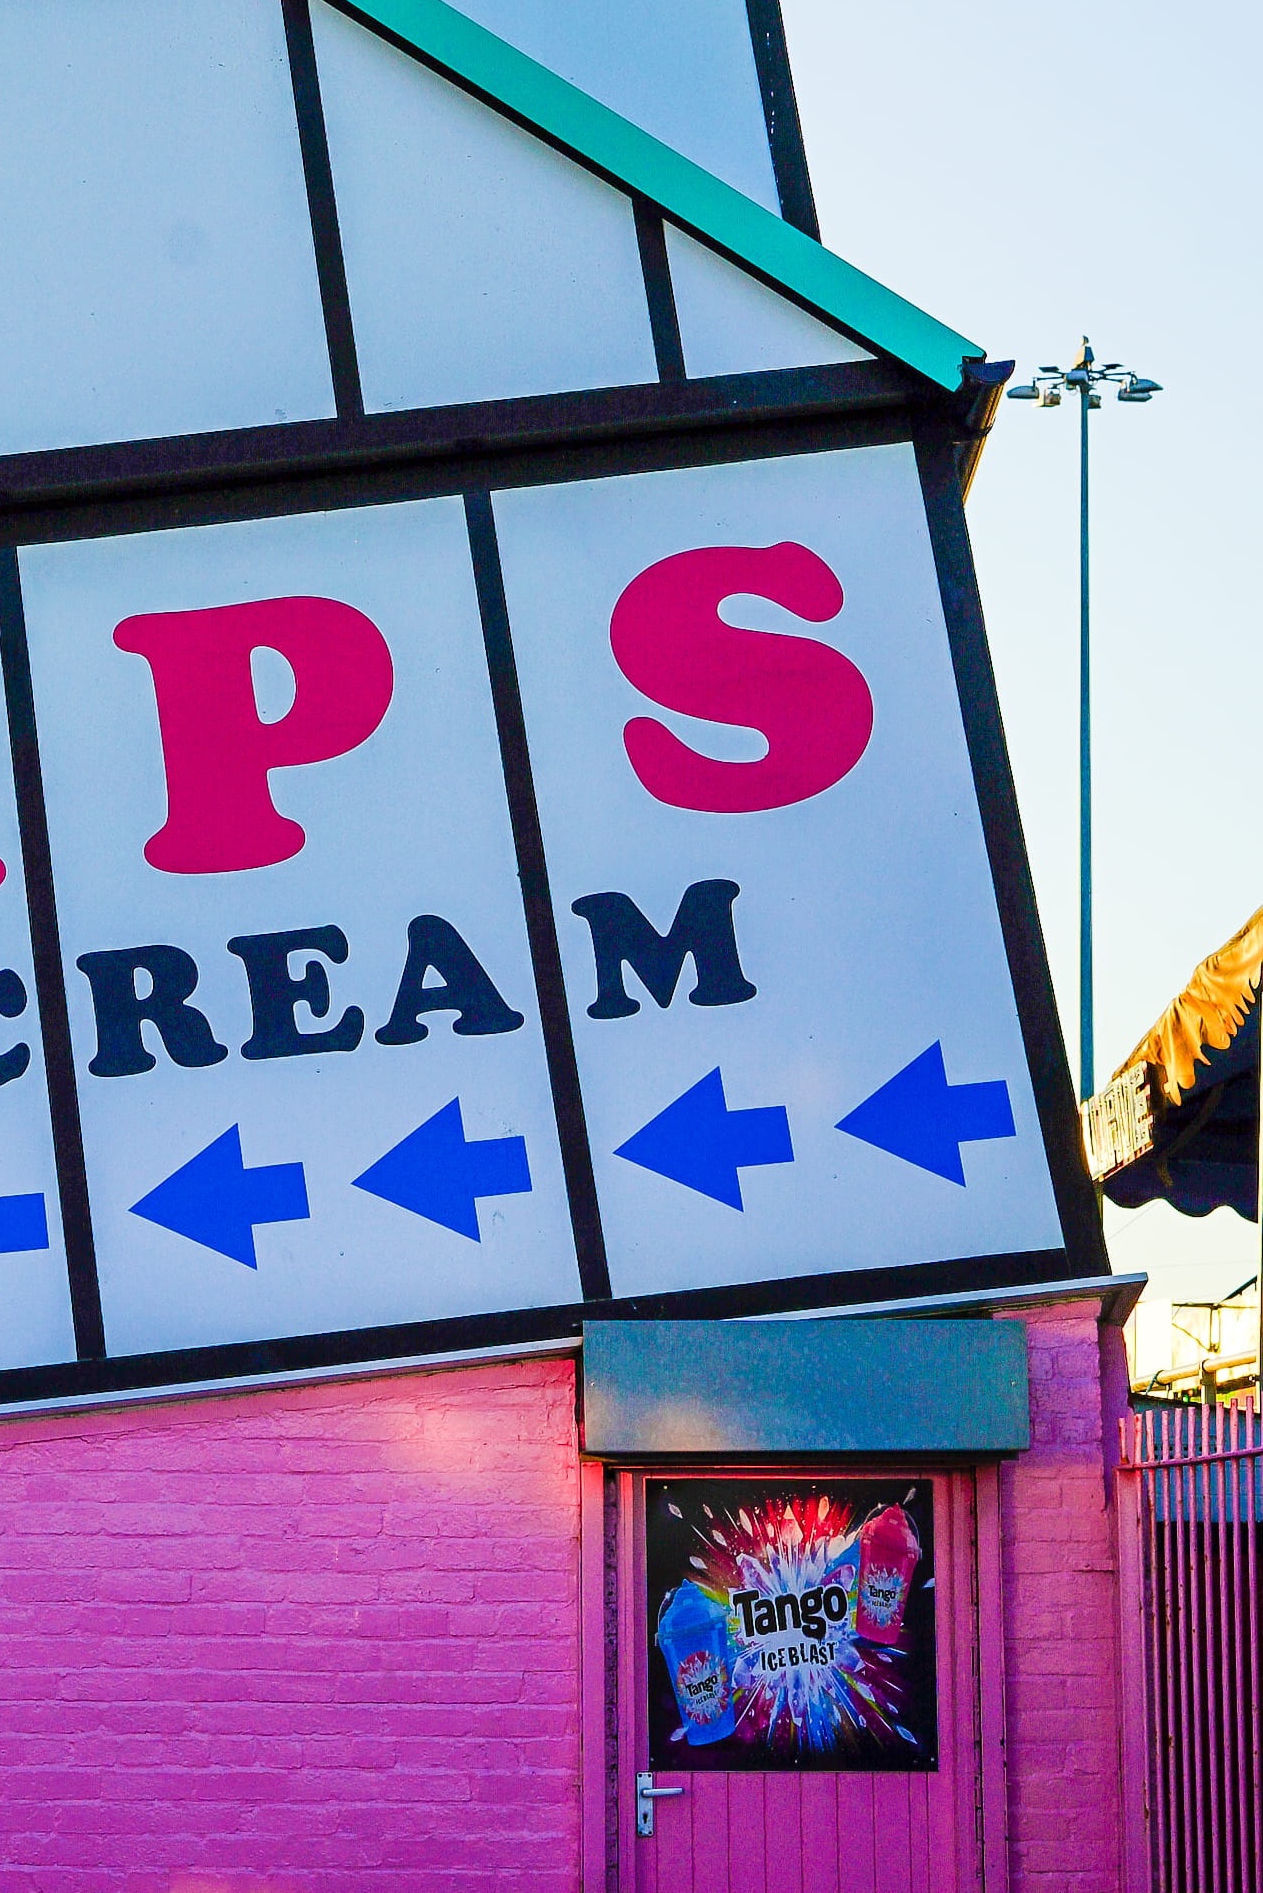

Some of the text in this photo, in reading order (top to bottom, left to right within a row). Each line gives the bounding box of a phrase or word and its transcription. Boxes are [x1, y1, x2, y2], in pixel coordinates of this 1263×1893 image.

[868, 1585, 896, 1602] Tango
[733, 1586, 847, 1644] Tango
[686, 1675, 717, 1696] Tango
